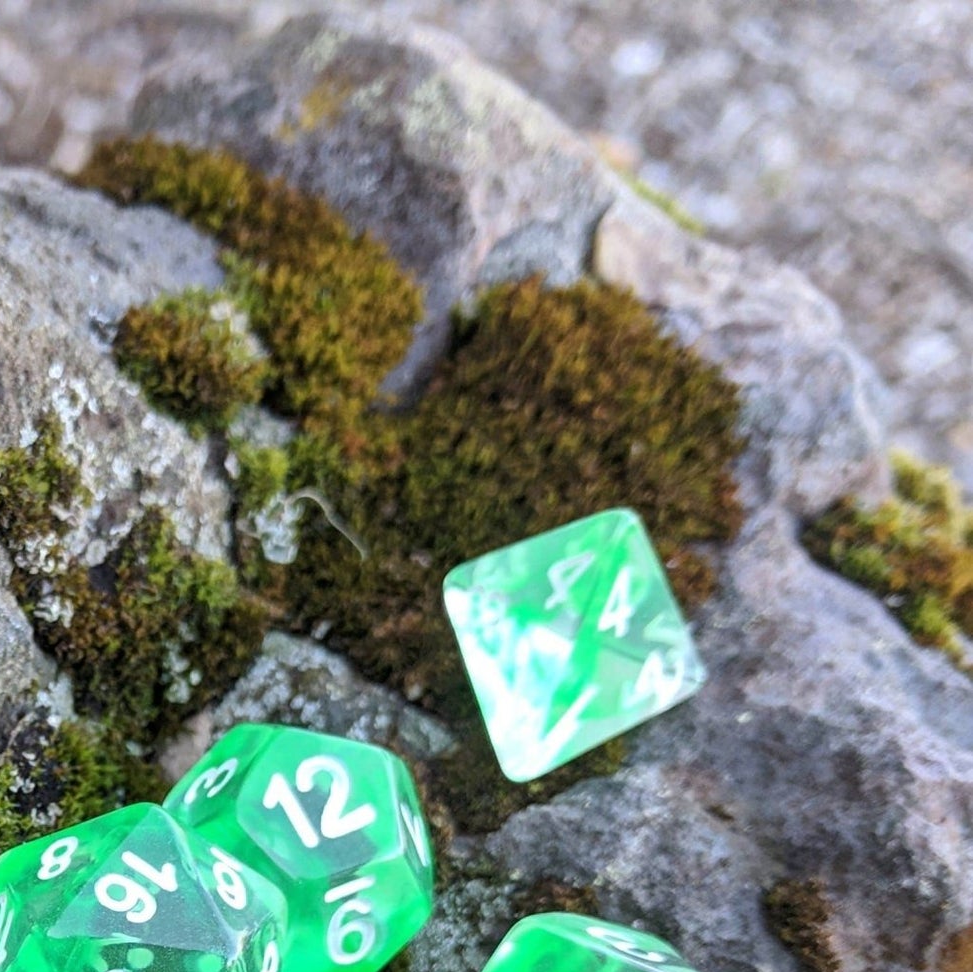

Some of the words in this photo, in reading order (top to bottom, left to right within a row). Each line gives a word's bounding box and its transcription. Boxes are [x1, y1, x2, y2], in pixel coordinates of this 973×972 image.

[598, 566, 635, 638] 4
[184, 758, 238, 805] 3
[262, 754, 376, 849] 12
[37, 835, 79, 881] 8
[94, 850, 178, 923] 16
[324, 875, 375, 965] 6
